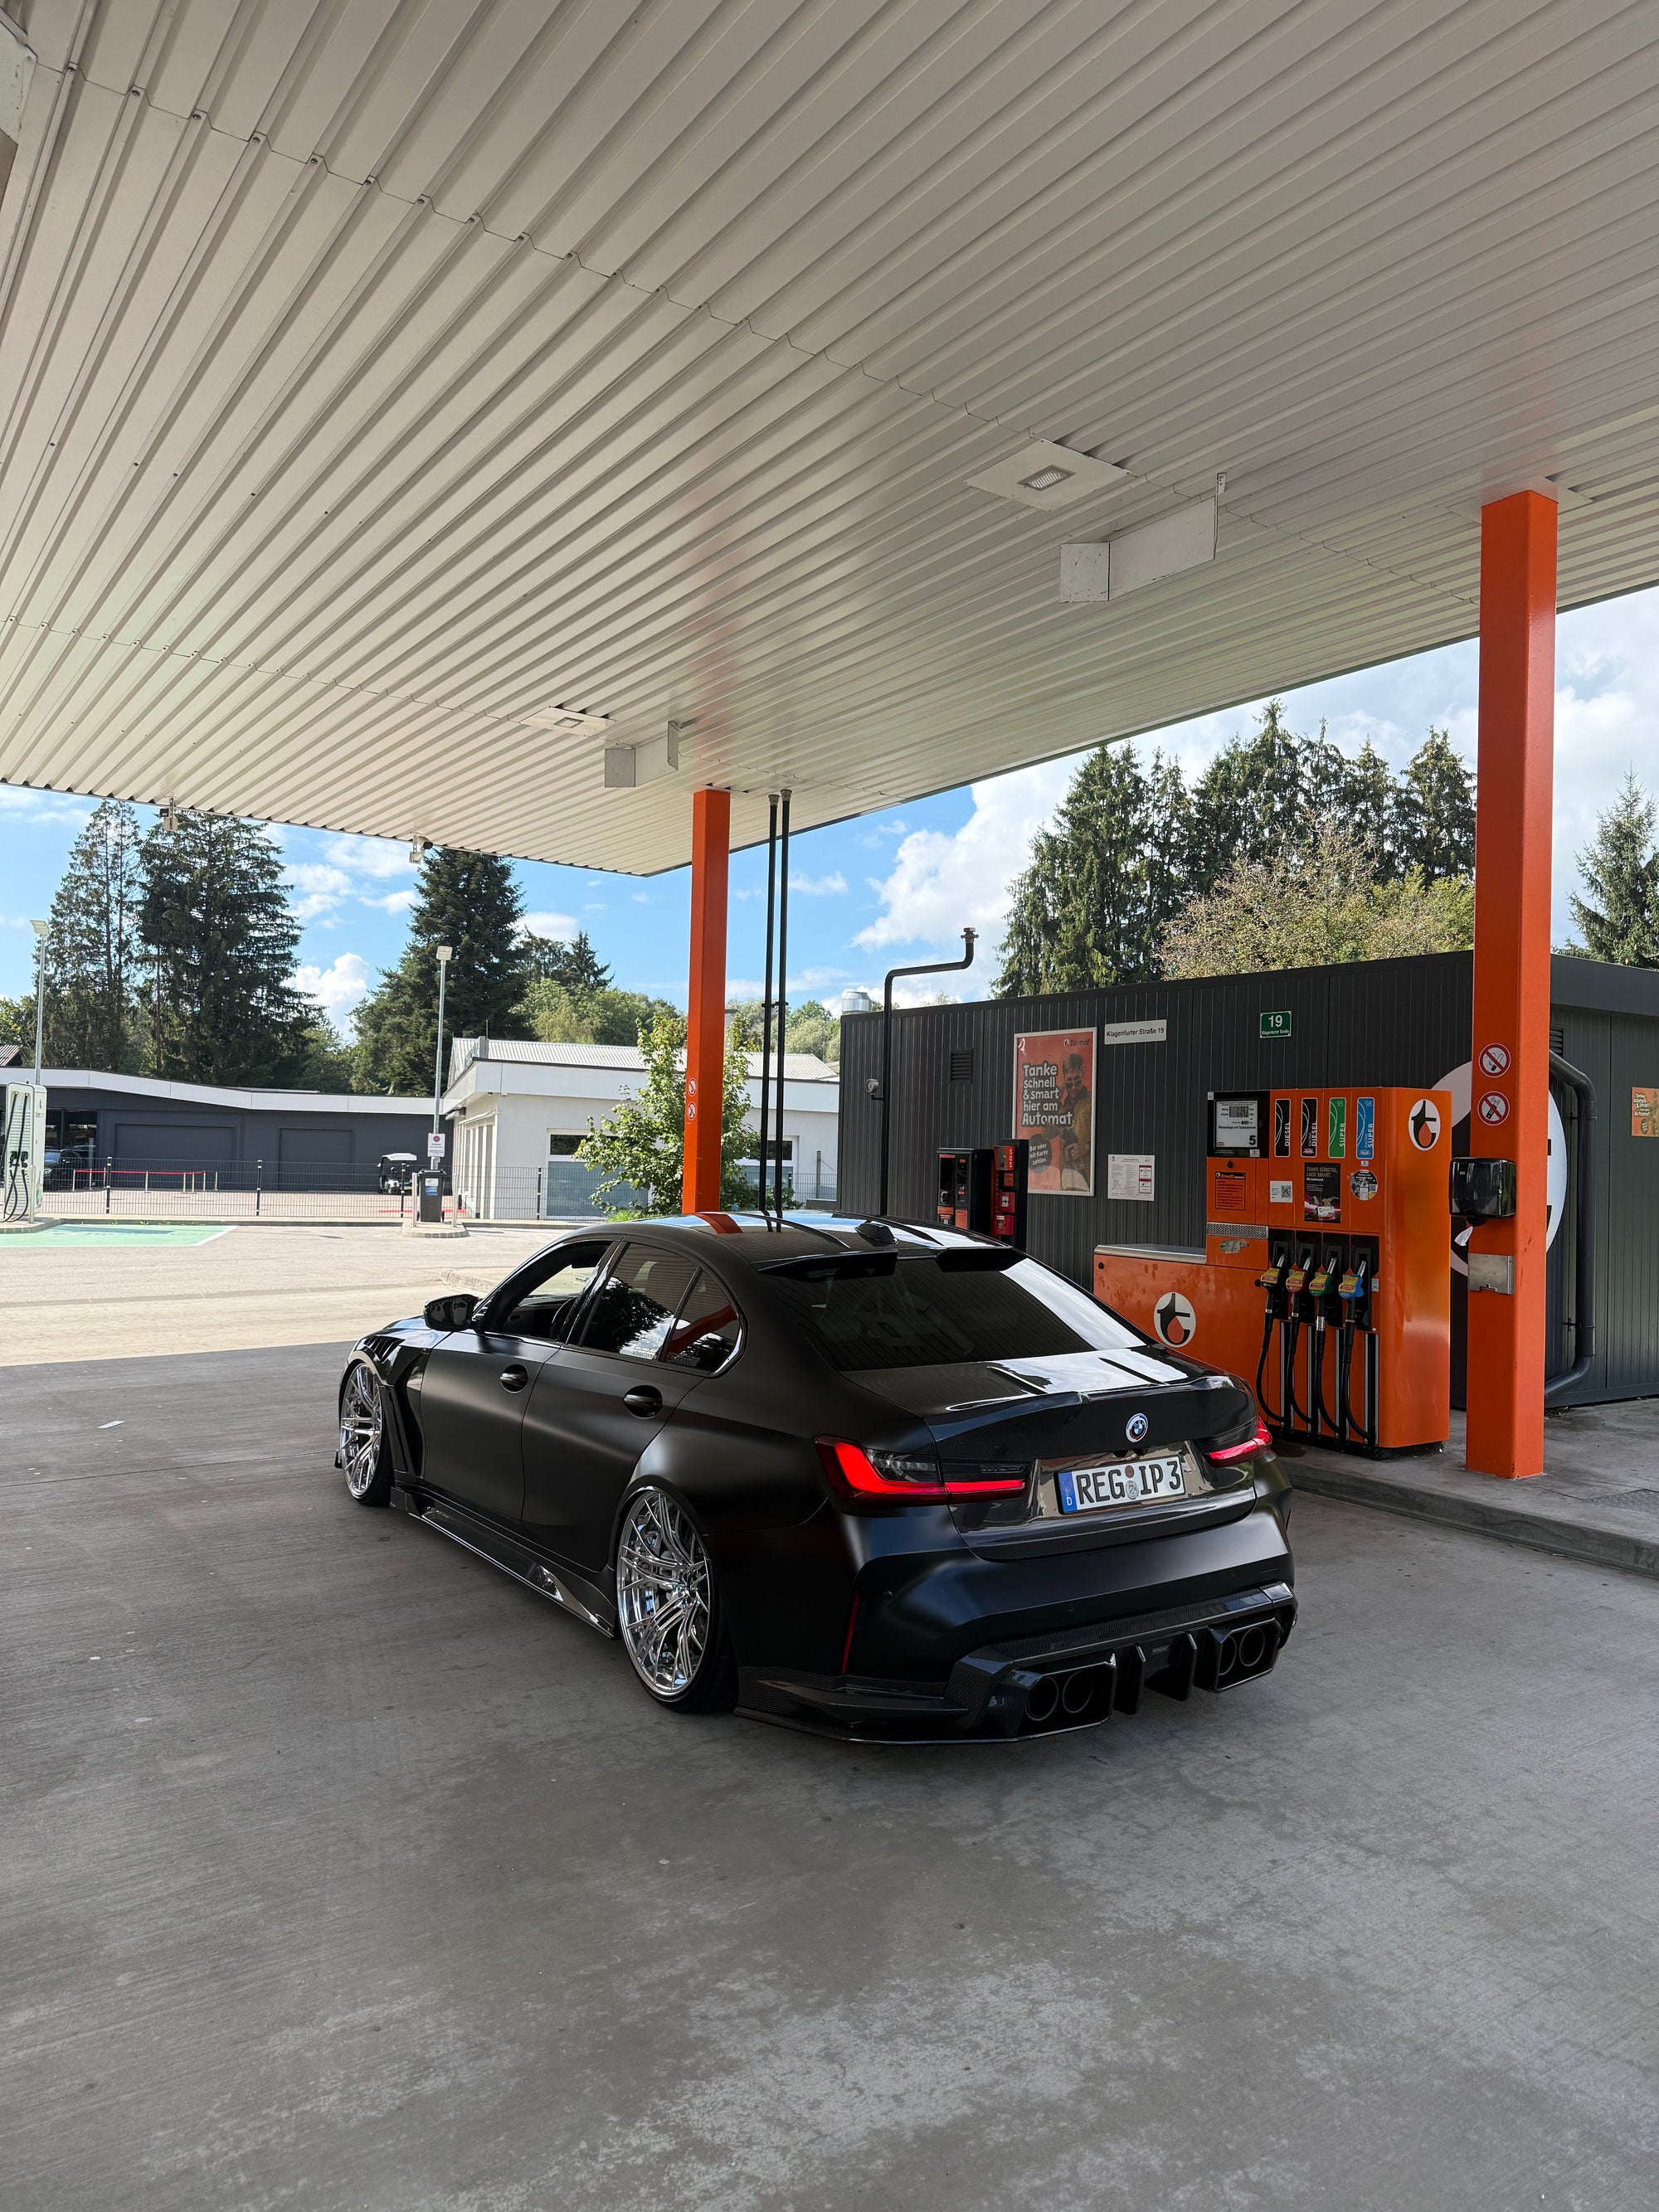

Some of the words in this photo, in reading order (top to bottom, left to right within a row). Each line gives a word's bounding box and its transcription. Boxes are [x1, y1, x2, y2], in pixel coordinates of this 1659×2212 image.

[1268, 1014, 1283, 1028] 19
[1107, 1029, 1138, 1038] Klagenfurter
[1023, 1062, 1058, 1077] Tanke
[1024, 1077, 1055, 1089] schnell
[1023, 1101, 1040, 1112] hier
[1043, 1102, 1058, 1112] am
[1022, 1111, 1073, 1125] Automat
[1248, 1135, 1257, 1145] 5
[1076, 1469, 1126, 1505] REG
[1138, 1463, 1164, 1495] IP
[1166, 1460, 1181, 1490] 3
[1066, 1496, 1073, 1506] D
